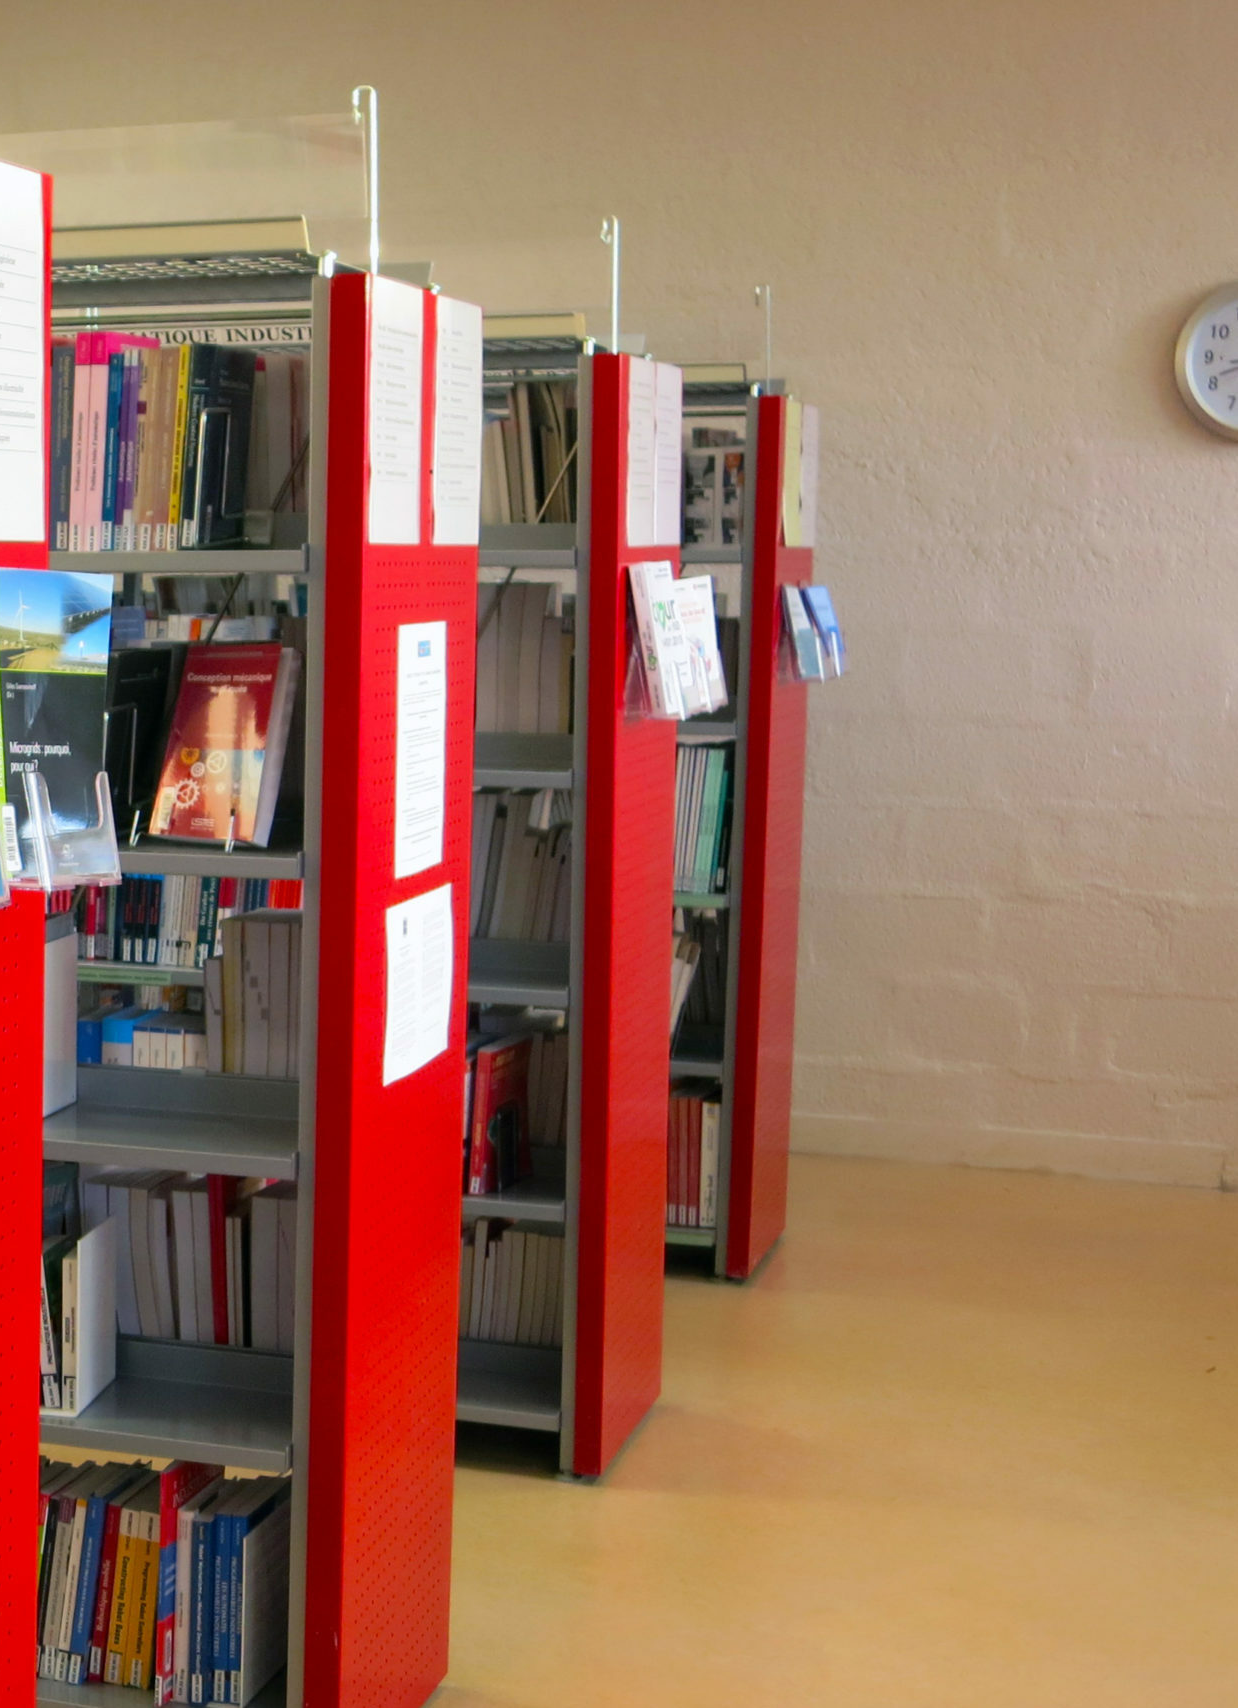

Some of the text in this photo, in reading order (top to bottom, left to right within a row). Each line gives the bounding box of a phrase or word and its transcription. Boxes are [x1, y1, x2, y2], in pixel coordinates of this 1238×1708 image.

[1210, 323, 1230, 340] 10
[1204, 349, 1214, 365] 9
[1208, 375, 1219, 391] 8
[1228, 395, 1237, 411] 7
[187, 672, 273, 684] Conception mécanique
[44, 741, 72, 758] pourquoi,
[117, 1555, 131, 1599] Constructing
[139, 1561, 151, 1600] Programming
[116, 1601, 126, 1622] Robot
